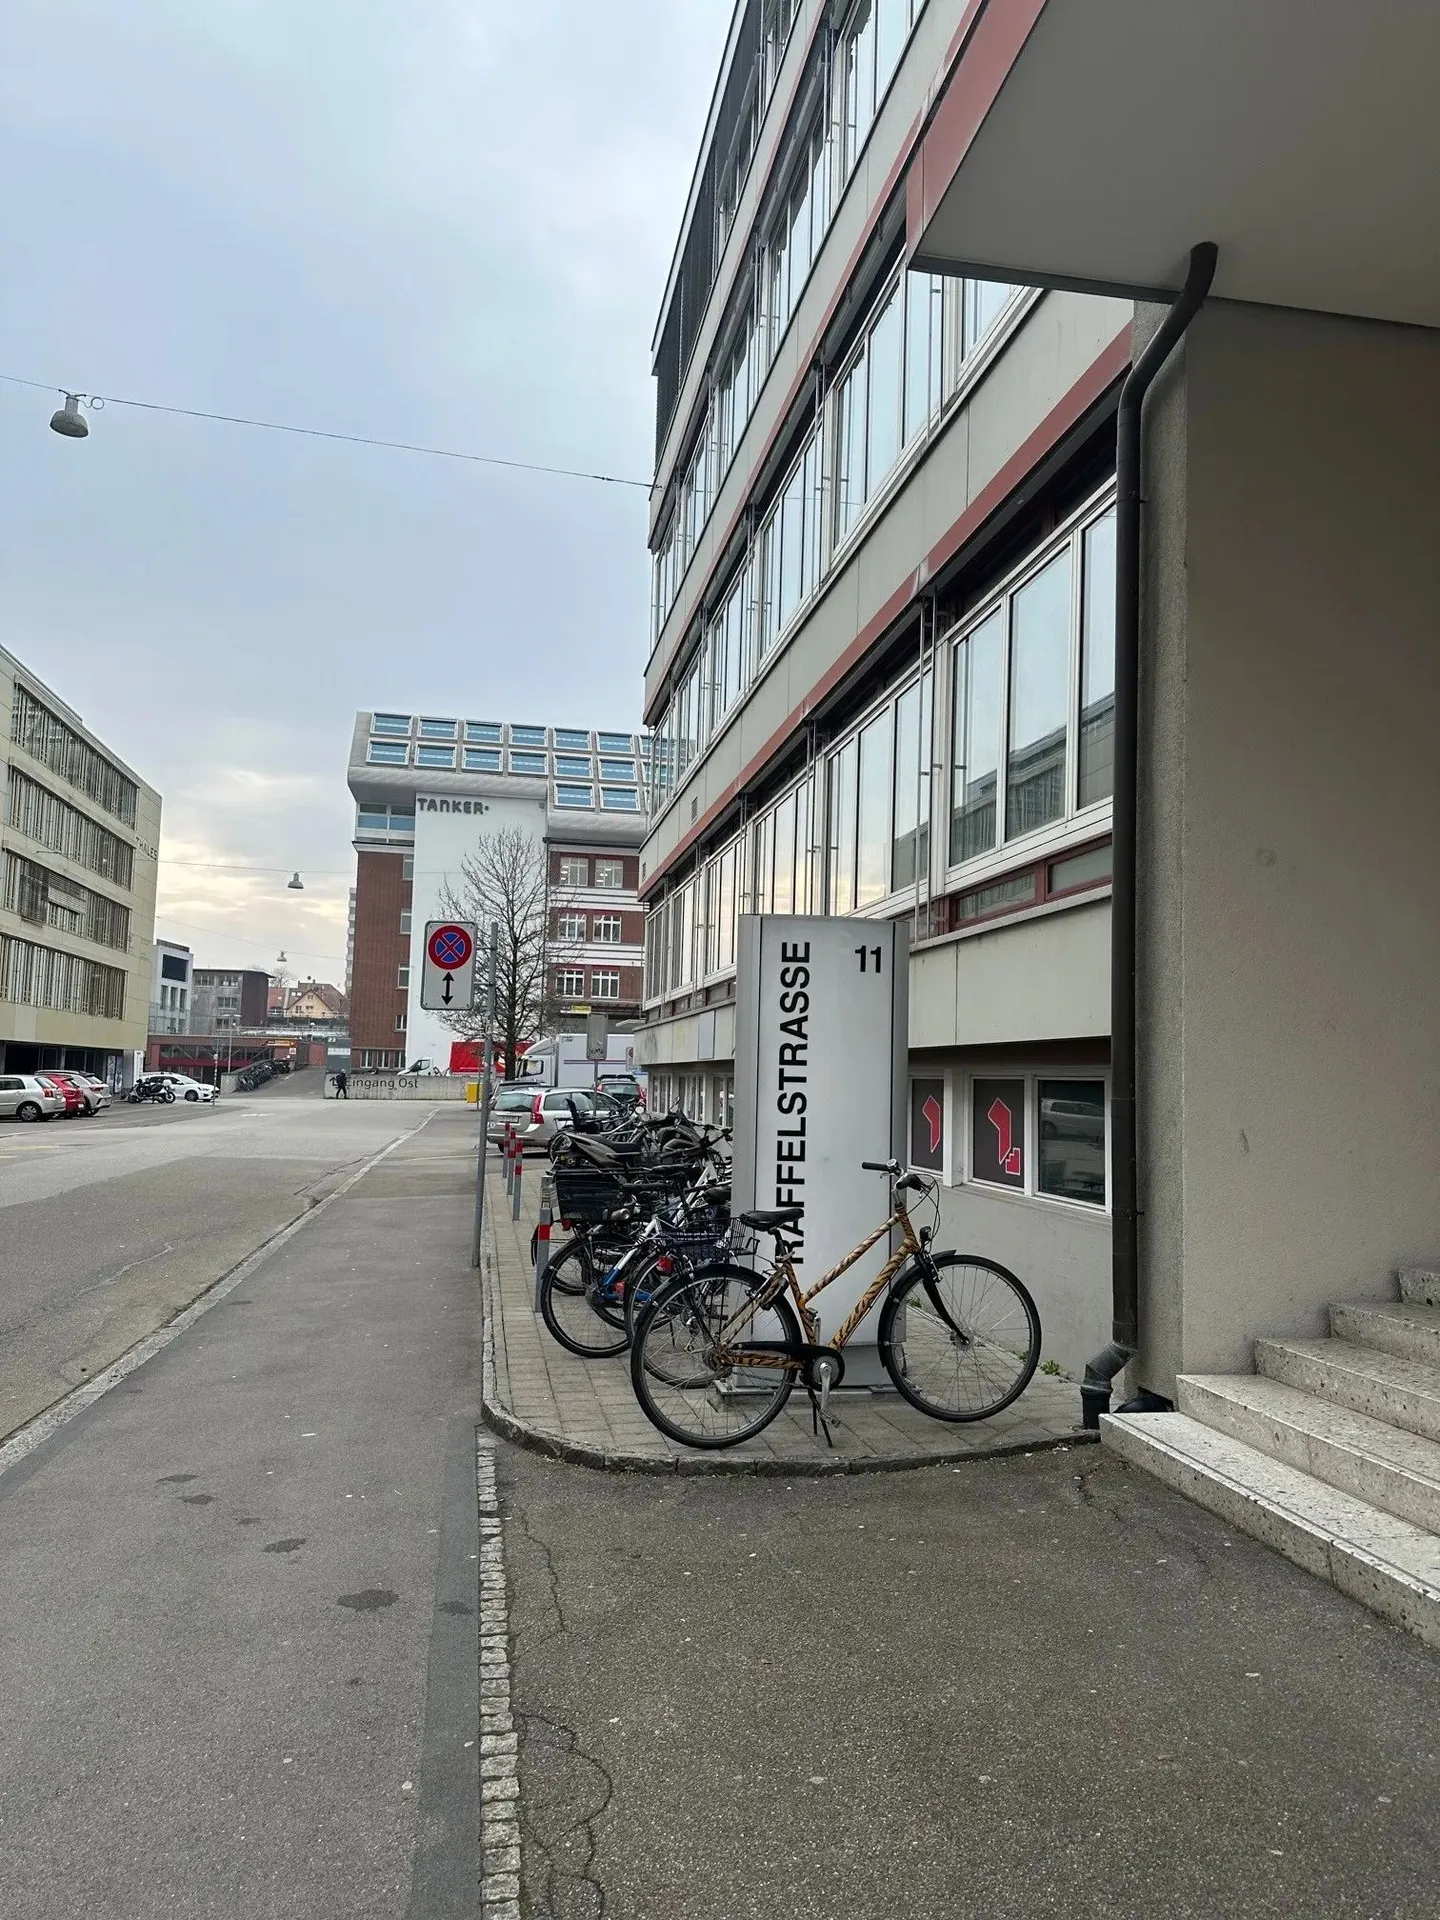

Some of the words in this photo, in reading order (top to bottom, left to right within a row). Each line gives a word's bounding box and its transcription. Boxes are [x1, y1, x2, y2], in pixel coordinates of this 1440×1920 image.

[417, 797, 484, 815] TANKER
[854, 945, 882, 973] 11
[398, 1077, 419, 1089] Ost
[774, 941, 811, 1264] RAFFELSTRASSE
